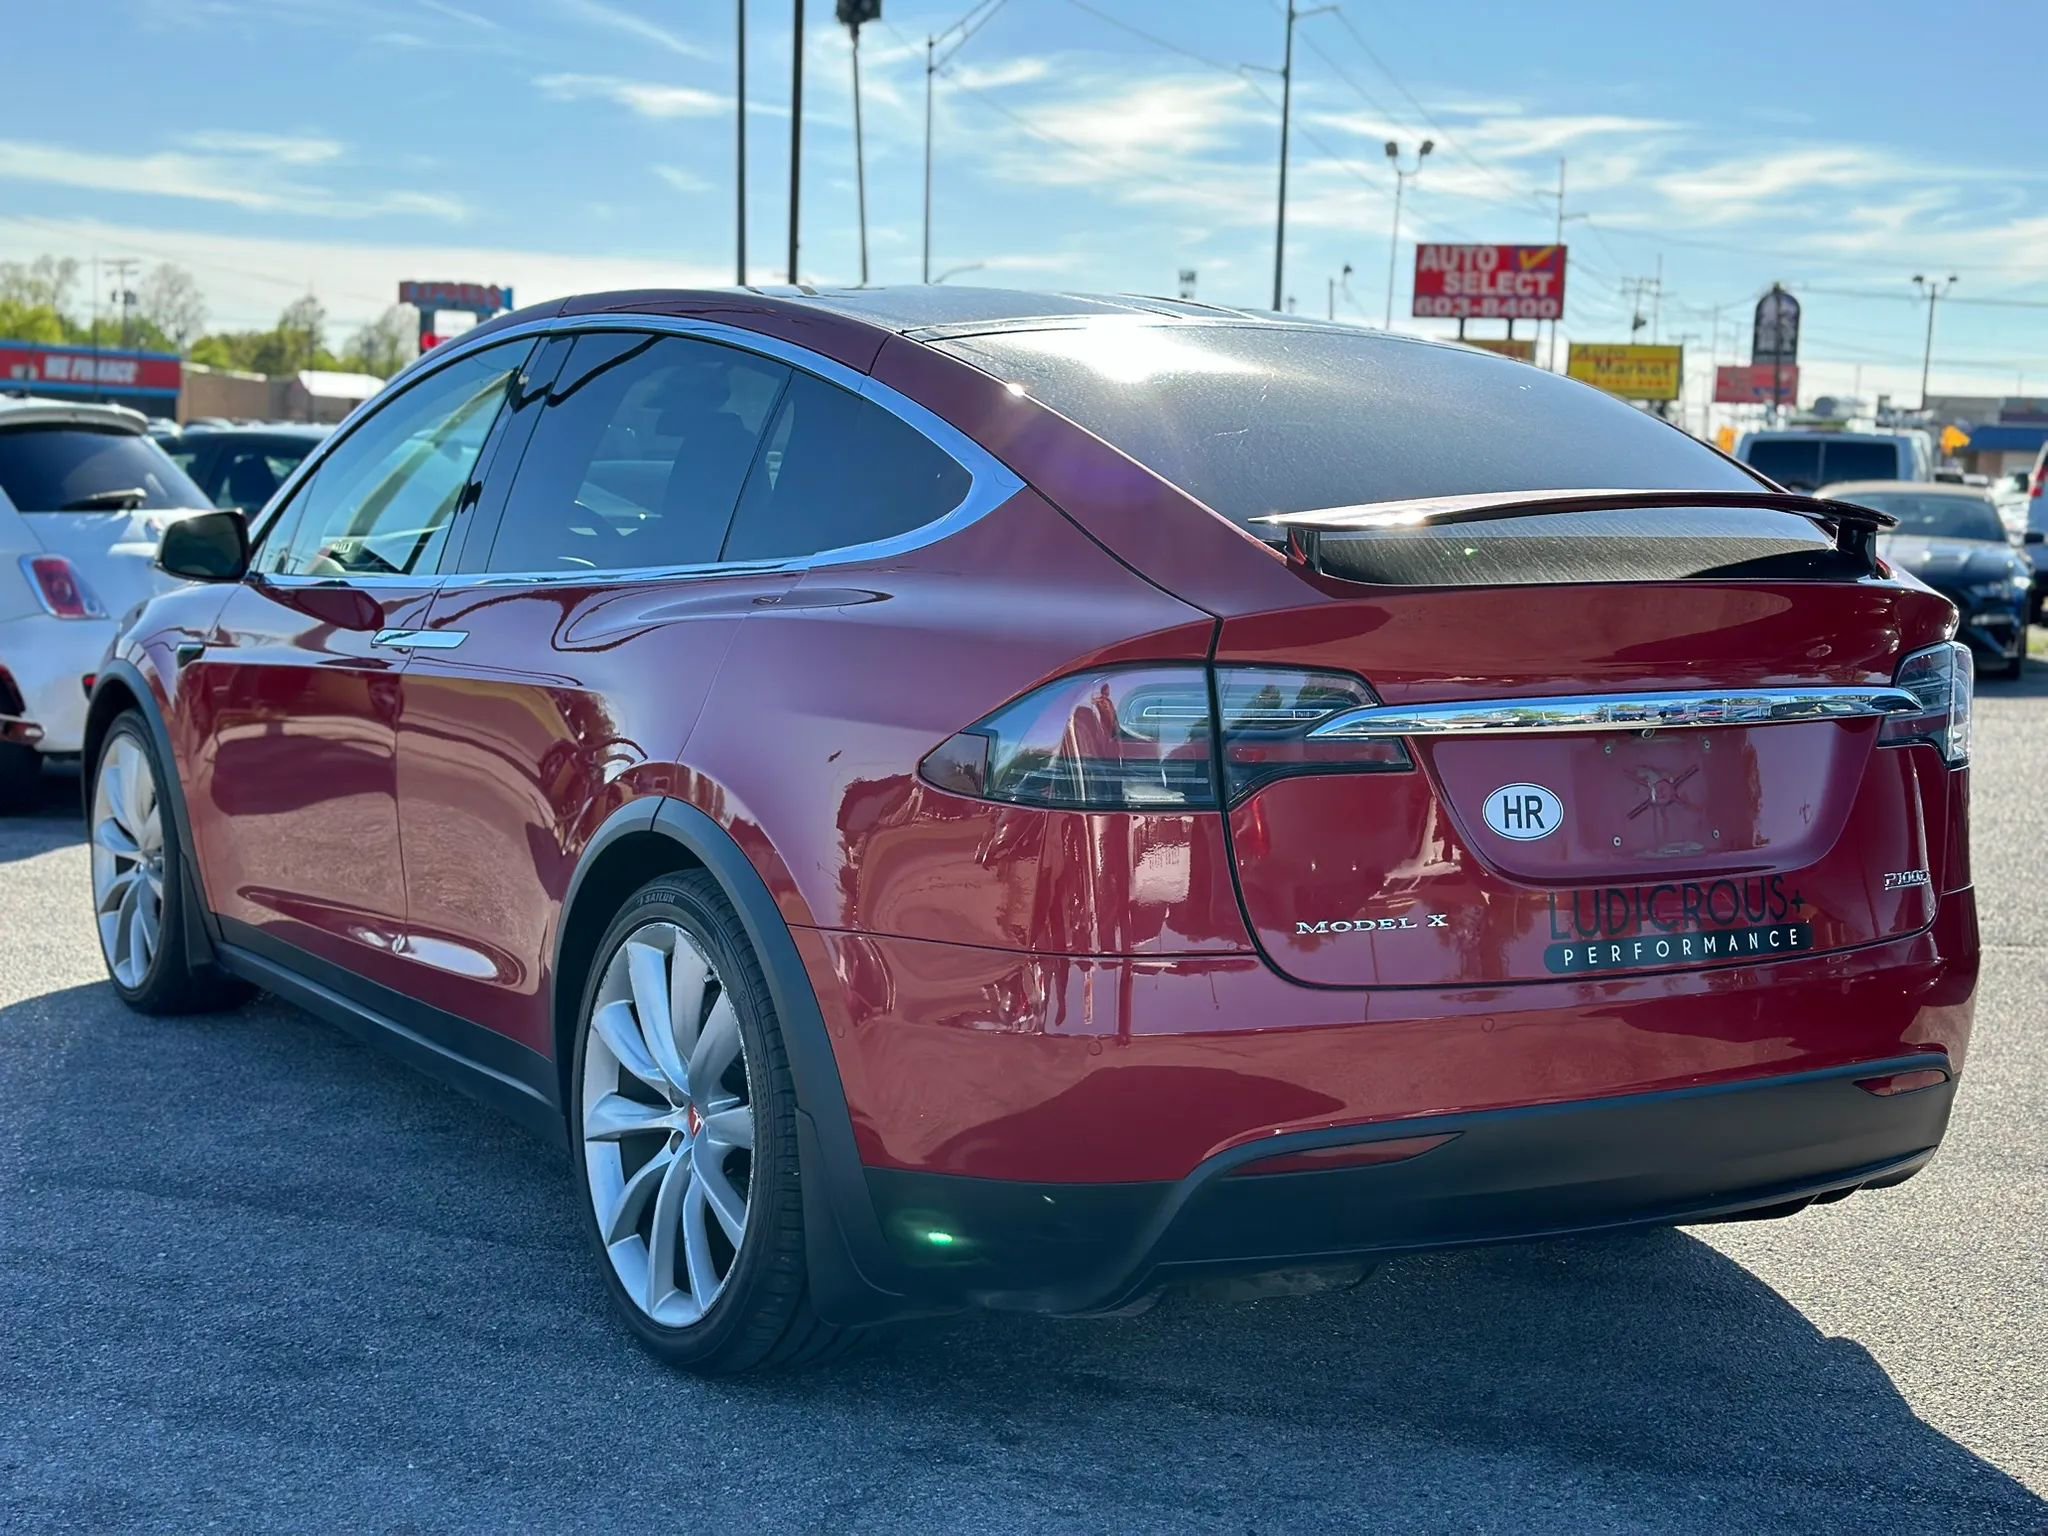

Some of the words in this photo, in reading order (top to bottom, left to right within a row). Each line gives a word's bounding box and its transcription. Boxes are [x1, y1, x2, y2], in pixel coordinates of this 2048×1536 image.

[1419, 246, 1498, 271] AUTO
[1443, 271, 1553, 296] SELECT
[1415, 296, 1558, 318] 603-8400
[1503, 795, 1545, 829] HR
[1551, 876, 1806, 940] LUDICROUS+
[1296, 917, 1418, 935] MODEL
[1427, 914, 1449, 928] X
[1564, 928, 1799, 966] PERFORMANCE
